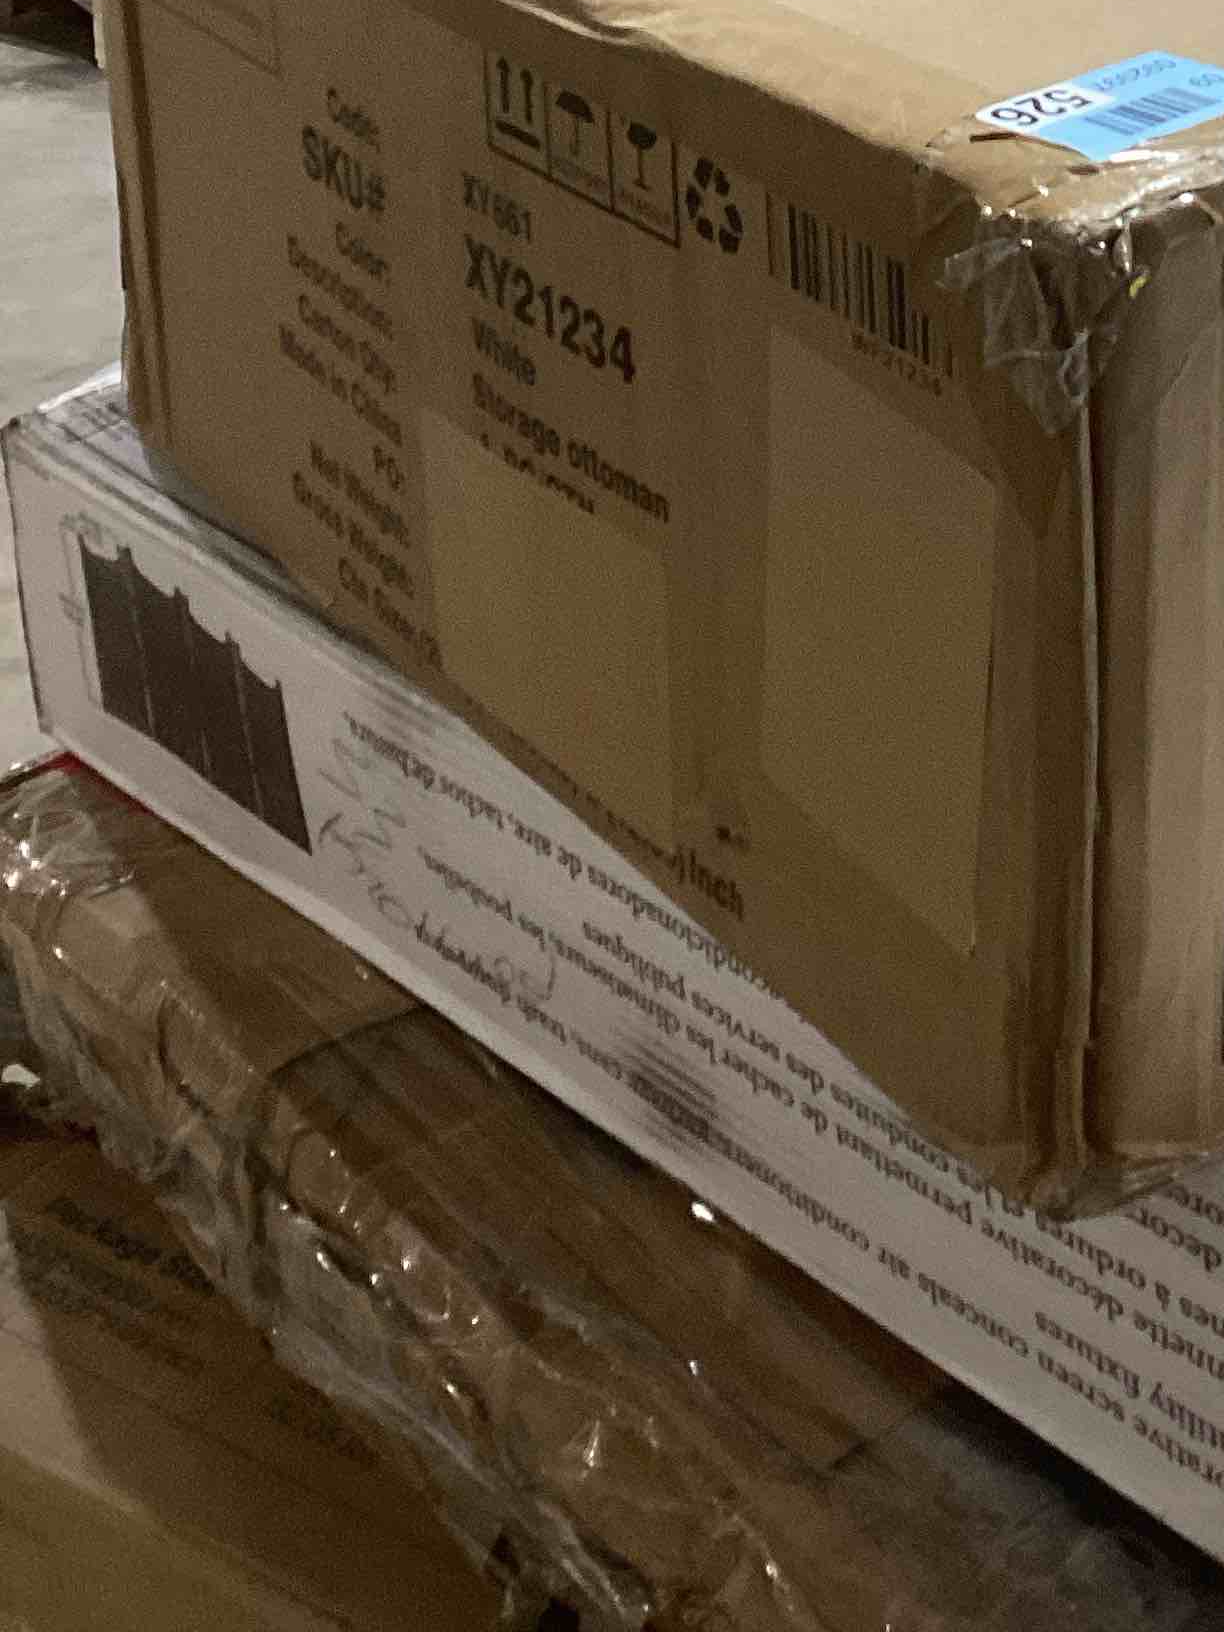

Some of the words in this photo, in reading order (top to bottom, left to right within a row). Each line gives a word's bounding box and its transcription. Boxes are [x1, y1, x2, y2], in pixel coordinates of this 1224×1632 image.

[989, 89, 1093, 127] 526
[463, 232, 637, 386] XY21234
[471, 370, 561, 458] Storage
[567, 437, 672, 524] ottoman
[556, 845, 584, 881] de
[579, 918, 687, 1004] publiques
[691, 978, 783, 1060] services
[715, 1044, 797, 1110] cacher
[784, 1048, 827, 1099] des
[798, 1099, 828, 1137] de
[836, 1112, 976, 1229] permettant
[876, 1245, 911, 1285] air
[915, 1271, 1031, 1360] conceals
[1034, 1311, 1140, 1398] fixtures
[1037, 1346, 1129, 1428] screen
